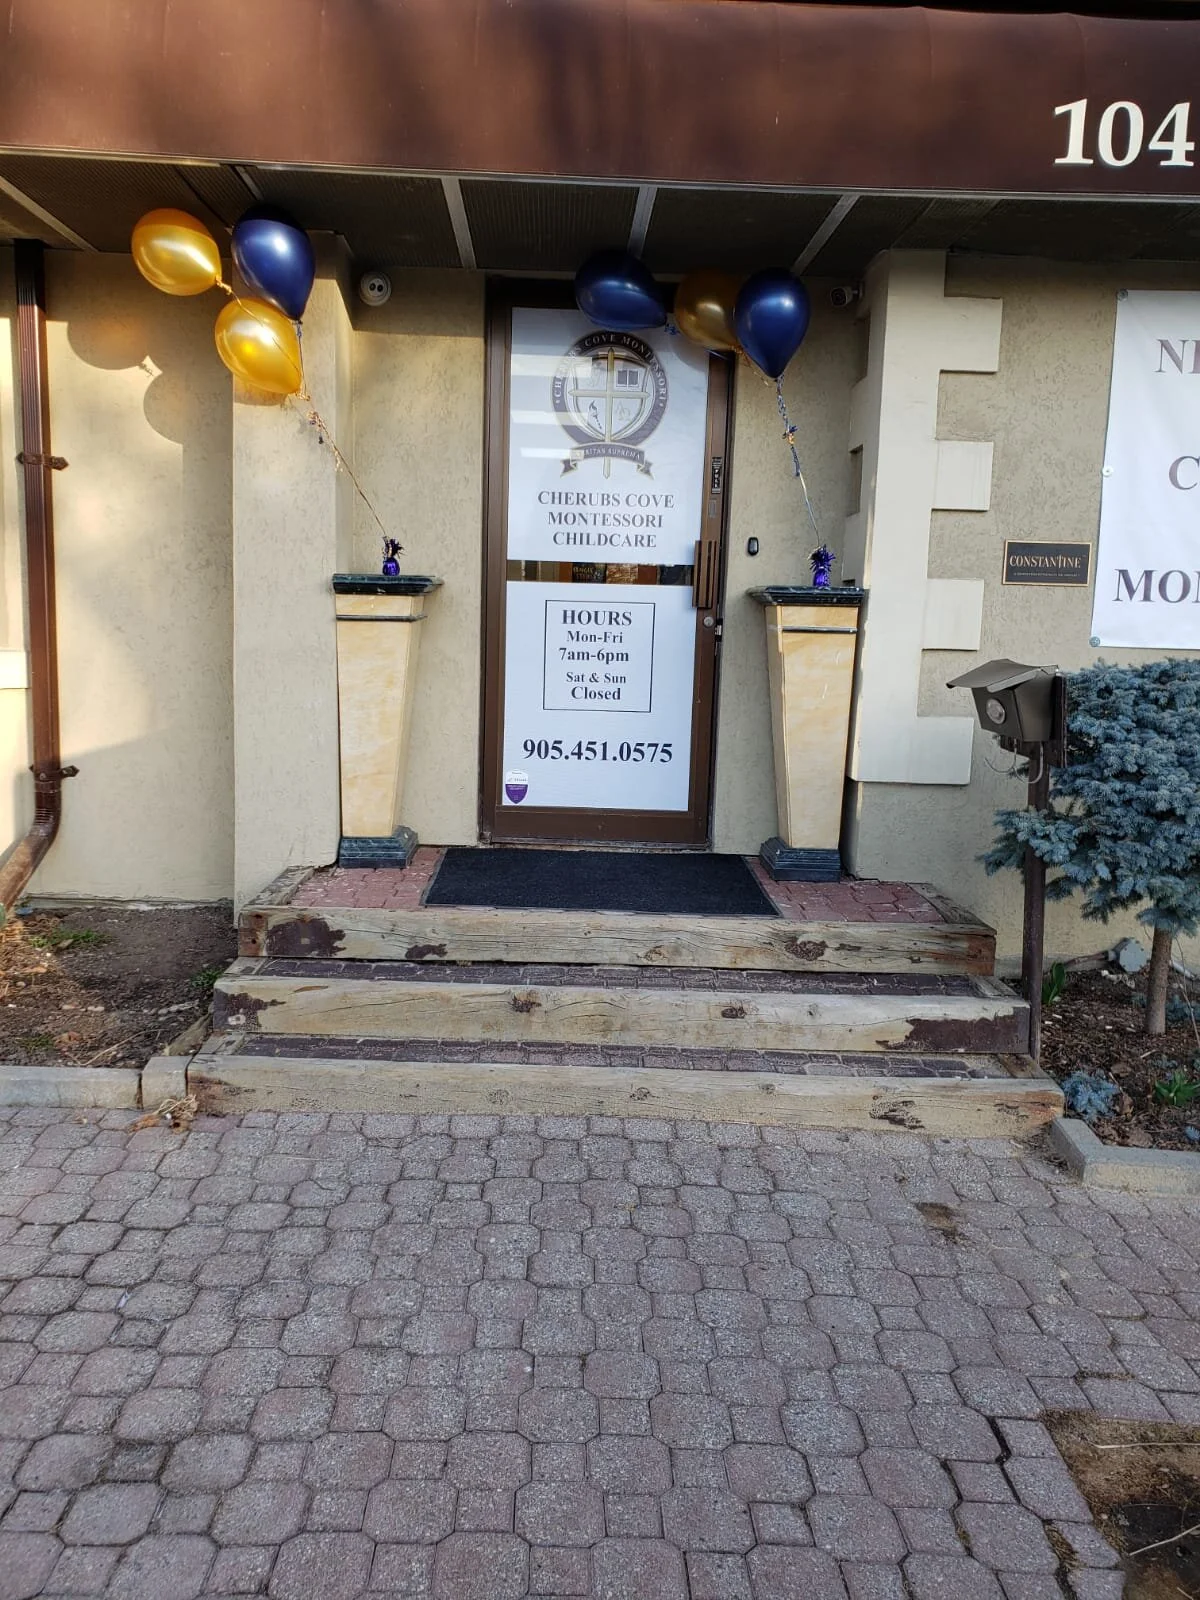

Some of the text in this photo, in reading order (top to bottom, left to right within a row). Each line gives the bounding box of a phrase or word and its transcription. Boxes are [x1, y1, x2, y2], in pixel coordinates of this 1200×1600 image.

[1054, 98, 1195, 167] 104
[584, 333, 616, 348] COVE
[538, 490, 675, 508] CHERUBS COVE
[548, 511, 663, 528] MONTESSORI
[553, 531, 657, 548] CHILDCARE
[1009, 554, 1081, 569] CONSTANTINE
[562, 609, 632, 626] HOURS
[567, 630, 623, 644] Mon-Fri
[559, 647, 629, 665] 7am-6pm
[566, 671, 627, 684] Sat & Sun
[571, 686, 621, 701] Closed
[523, 739, 673, 763] 905.451.0575
